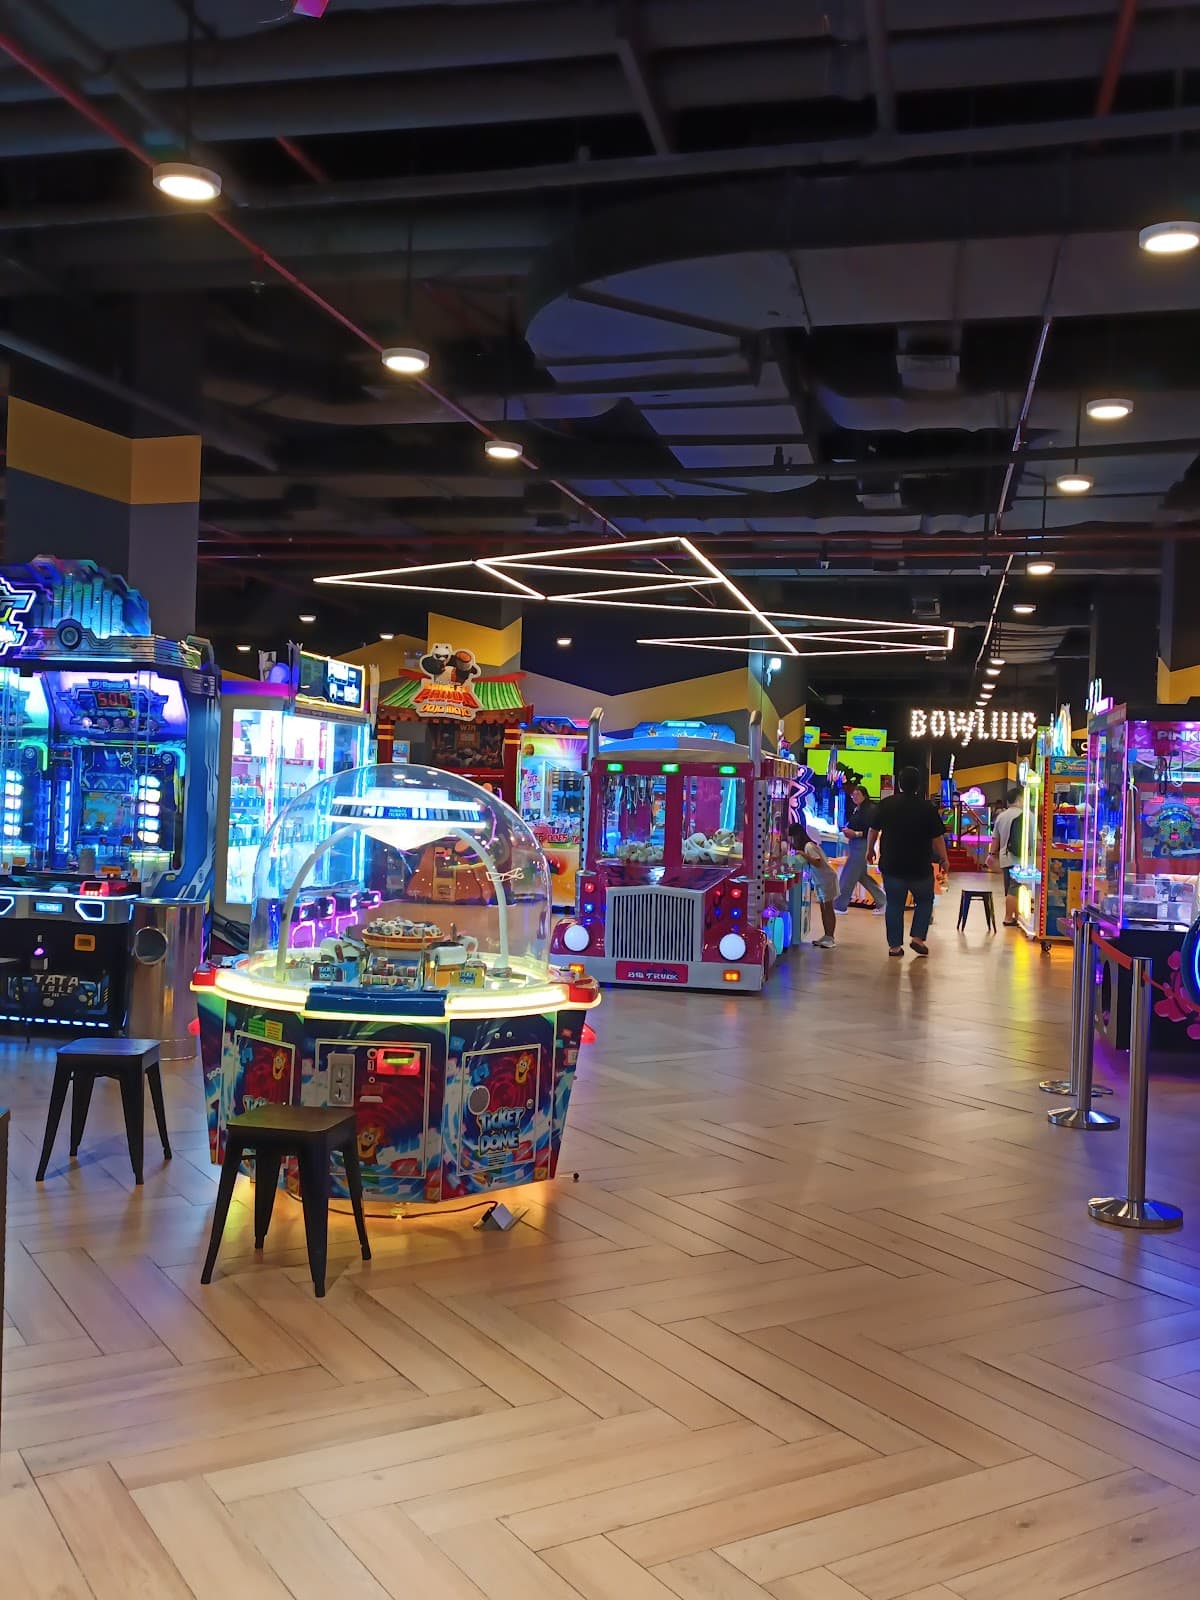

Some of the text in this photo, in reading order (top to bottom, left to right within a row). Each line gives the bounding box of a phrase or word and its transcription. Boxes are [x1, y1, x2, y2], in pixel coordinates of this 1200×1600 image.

[1157, 730, 1200, 742] PINK
[34, 974, 79, 986] TATA
[646, 972, 679, 980] TRUCK
[480, 1131, 519, 1153] DOME
